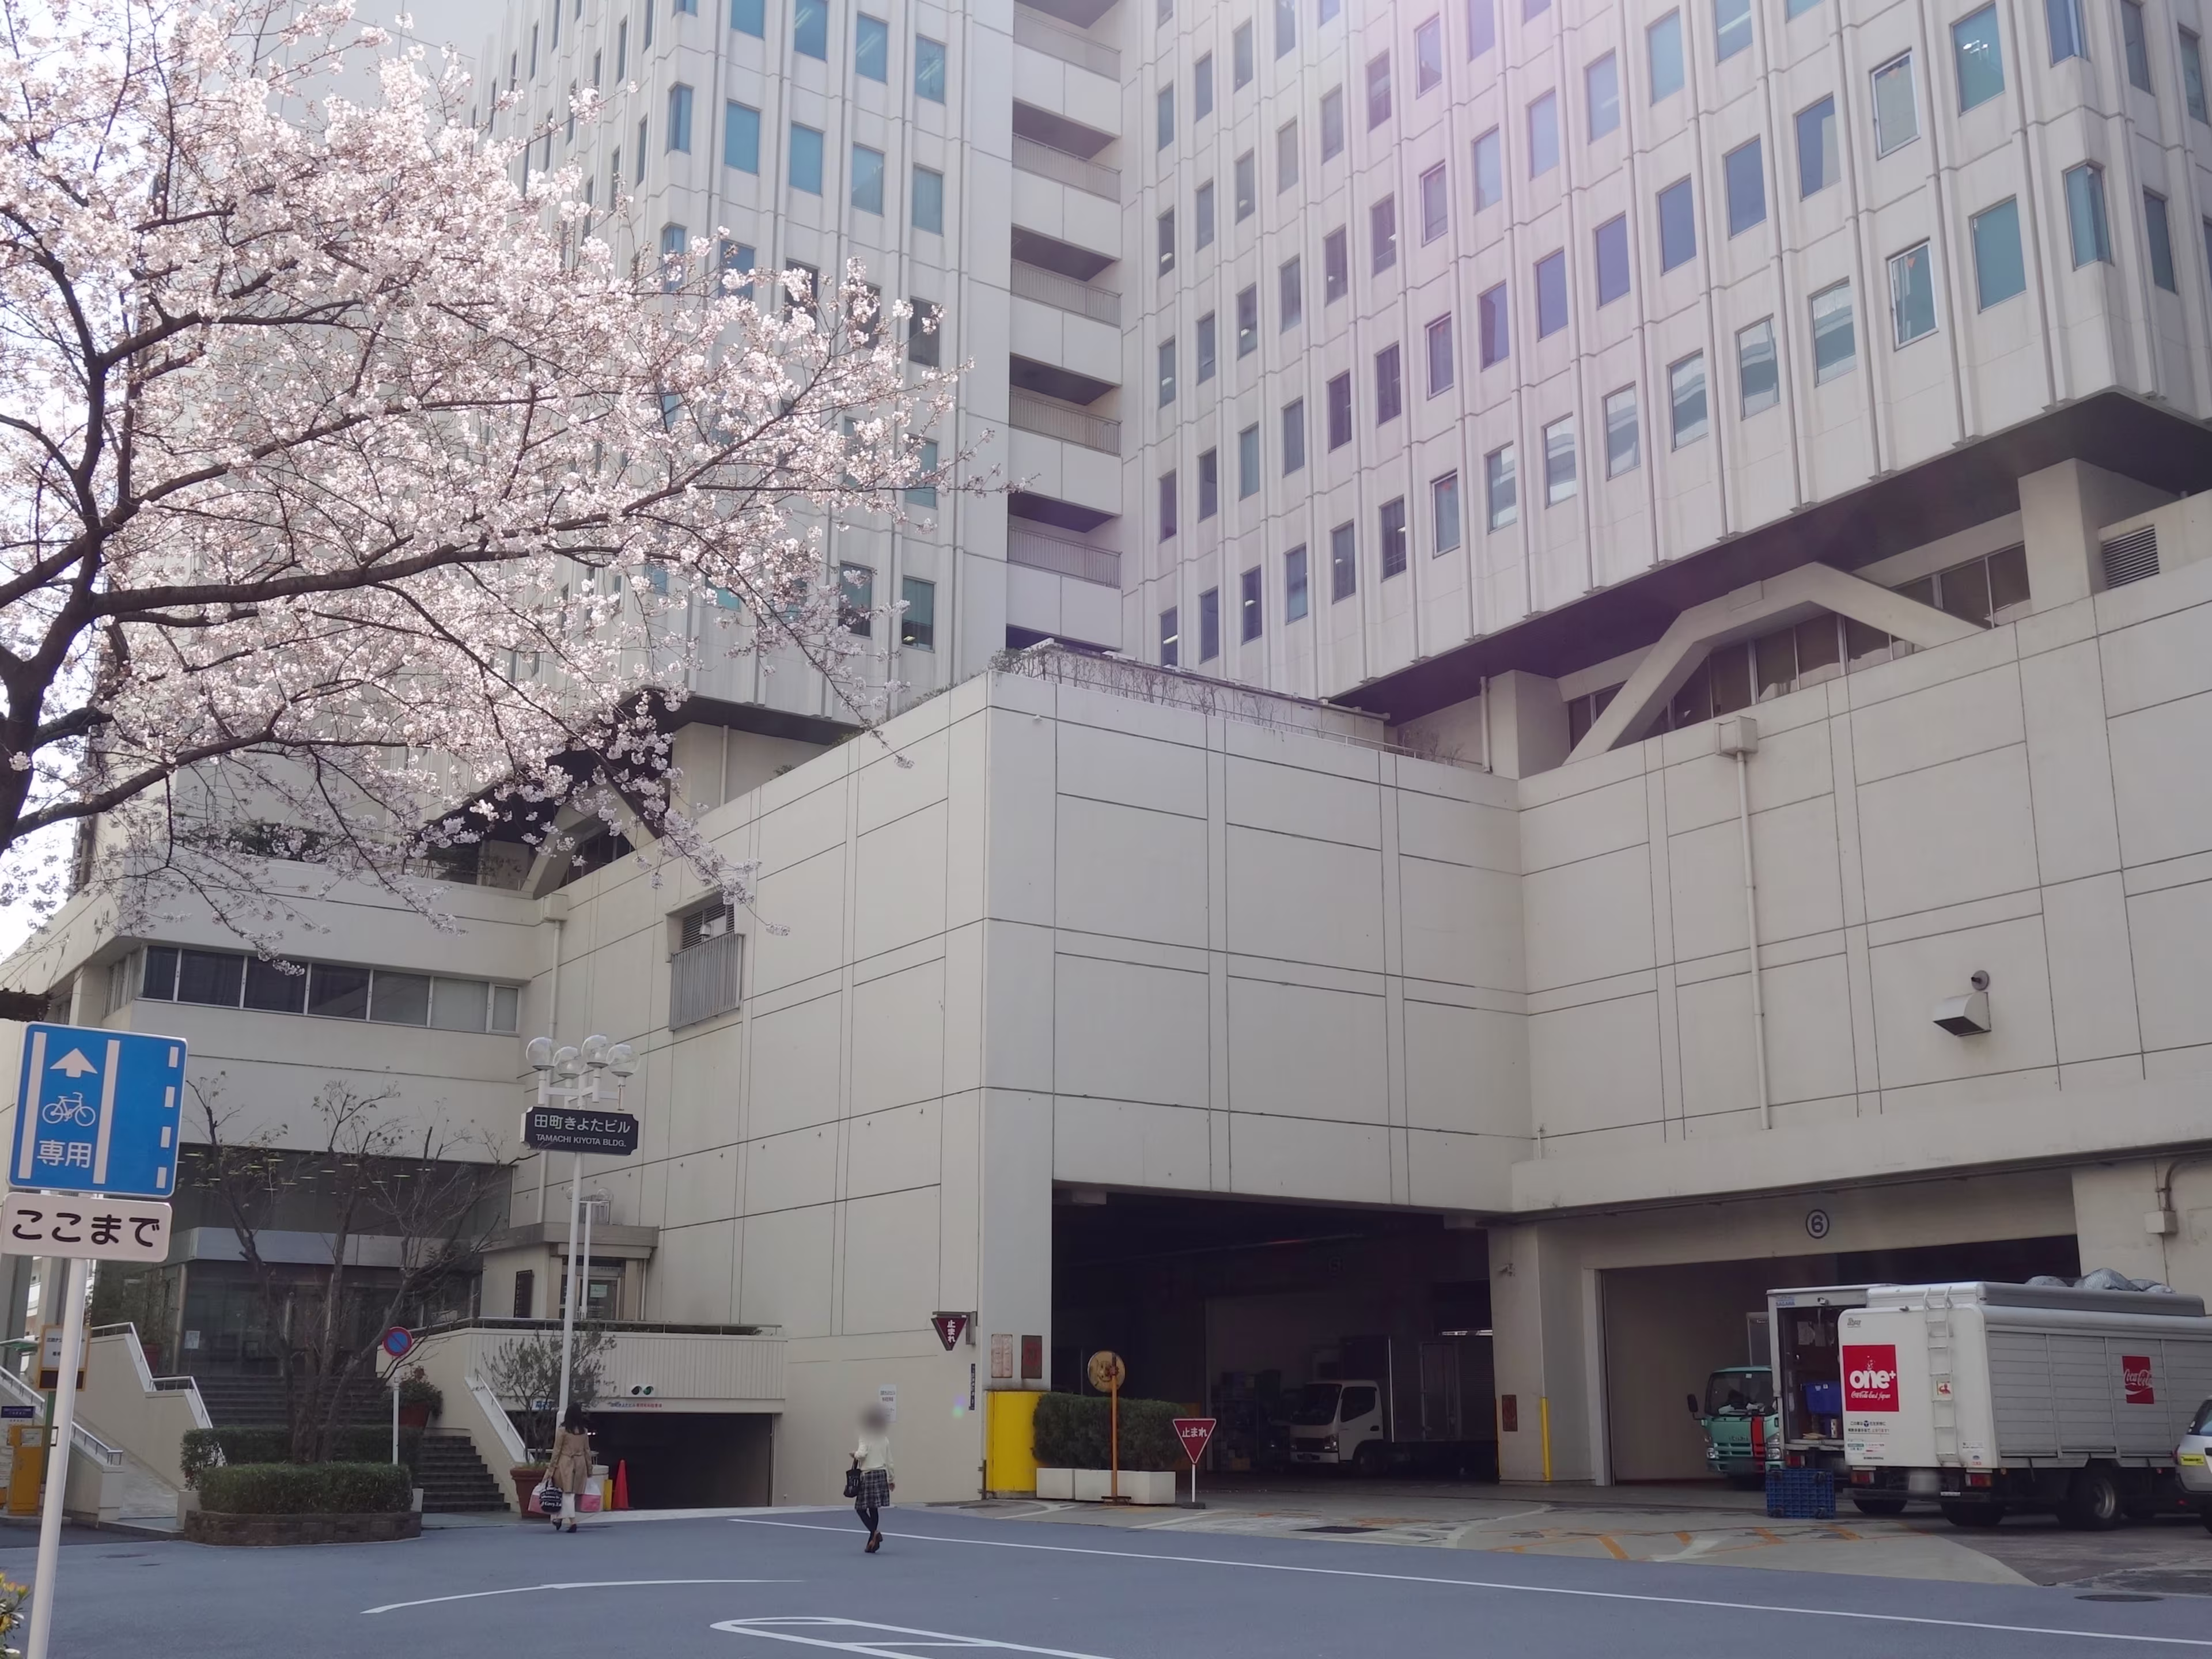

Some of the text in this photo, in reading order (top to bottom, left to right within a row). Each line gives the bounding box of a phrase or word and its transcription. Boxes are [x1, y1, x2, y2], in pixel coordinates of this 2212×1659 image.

[535, 1114, 631, 1134] 田町きよたビル
[536, 1134, 627, 1147] TAMACHI KIYOTA BLDG.
[36, 1138, 92, 1169] 専用
[12, 1209, 160, 1248] ここまで
[1811, 1214, 1824, 1233] 6
[946, 1319, 956, 1343] 止まれ
[1181, 1427, 1208, 1438] 止まれ
